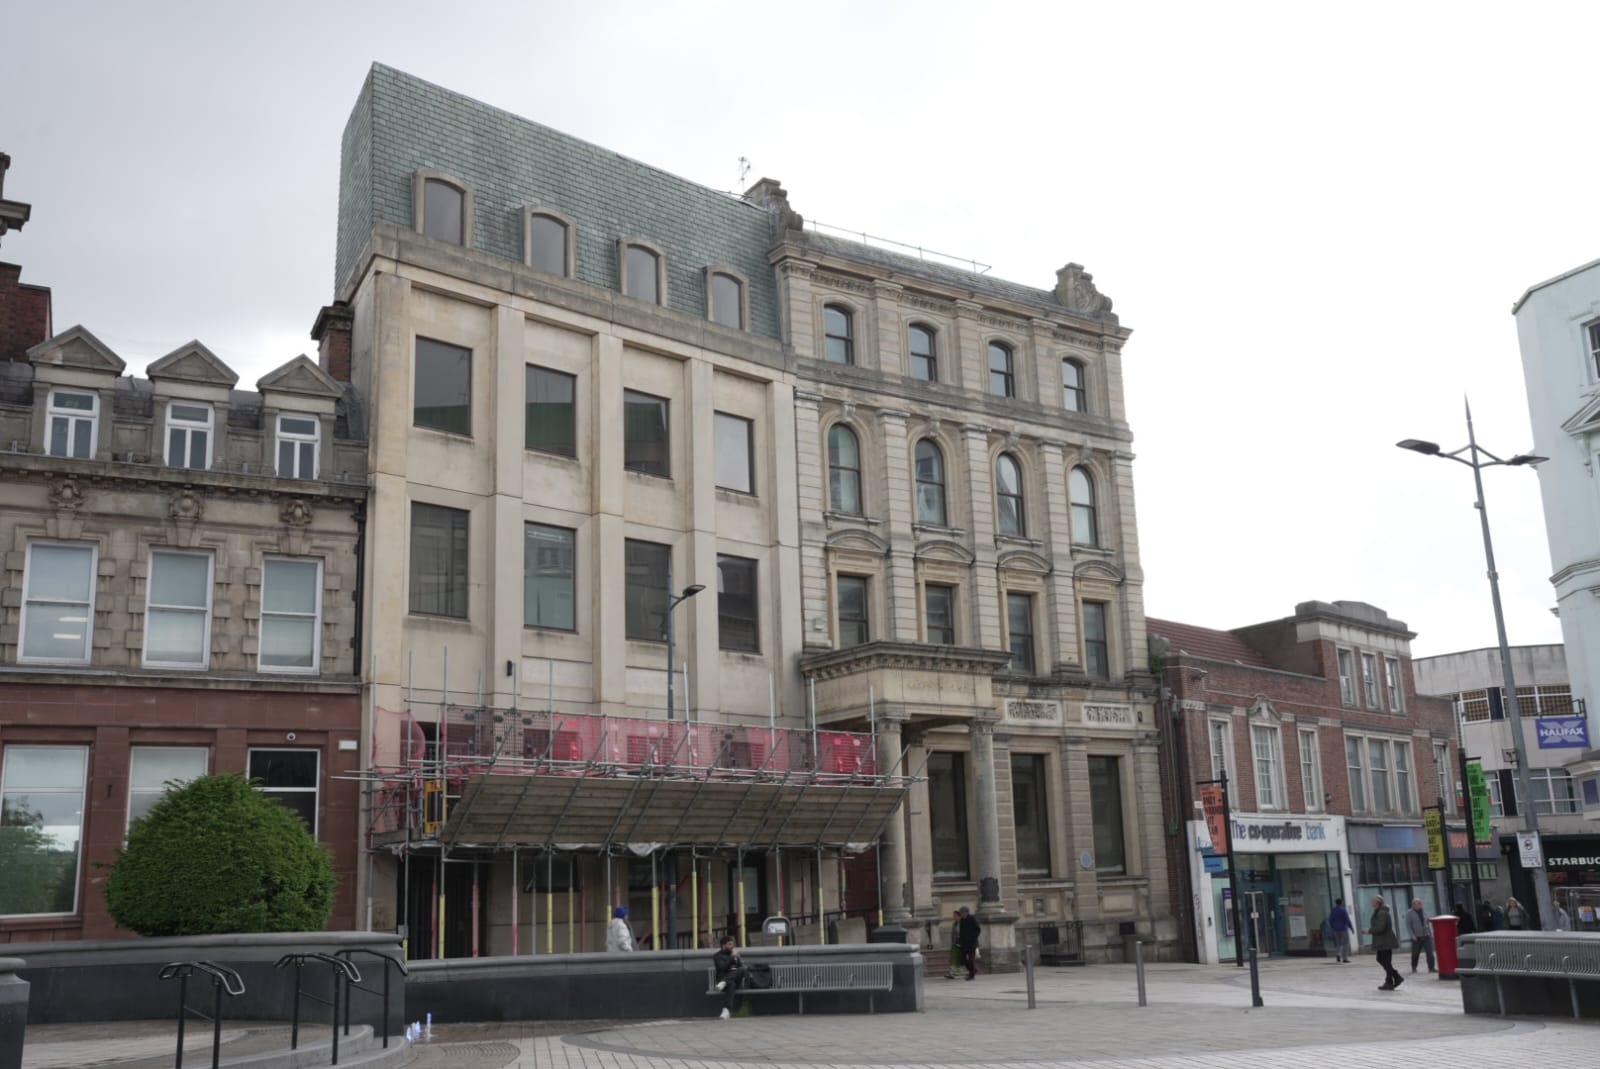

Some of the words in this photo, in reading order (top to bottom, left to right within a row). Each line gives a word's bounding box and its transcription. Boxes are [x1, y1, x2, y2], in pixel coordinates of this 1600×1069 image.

[1540, 727, 1584, 737] HALIFAX
[1230, 820, 1246, 839] The
[1248, 821, 1302, 844] co-operative
[1305, 821, 1327, 840] bank
